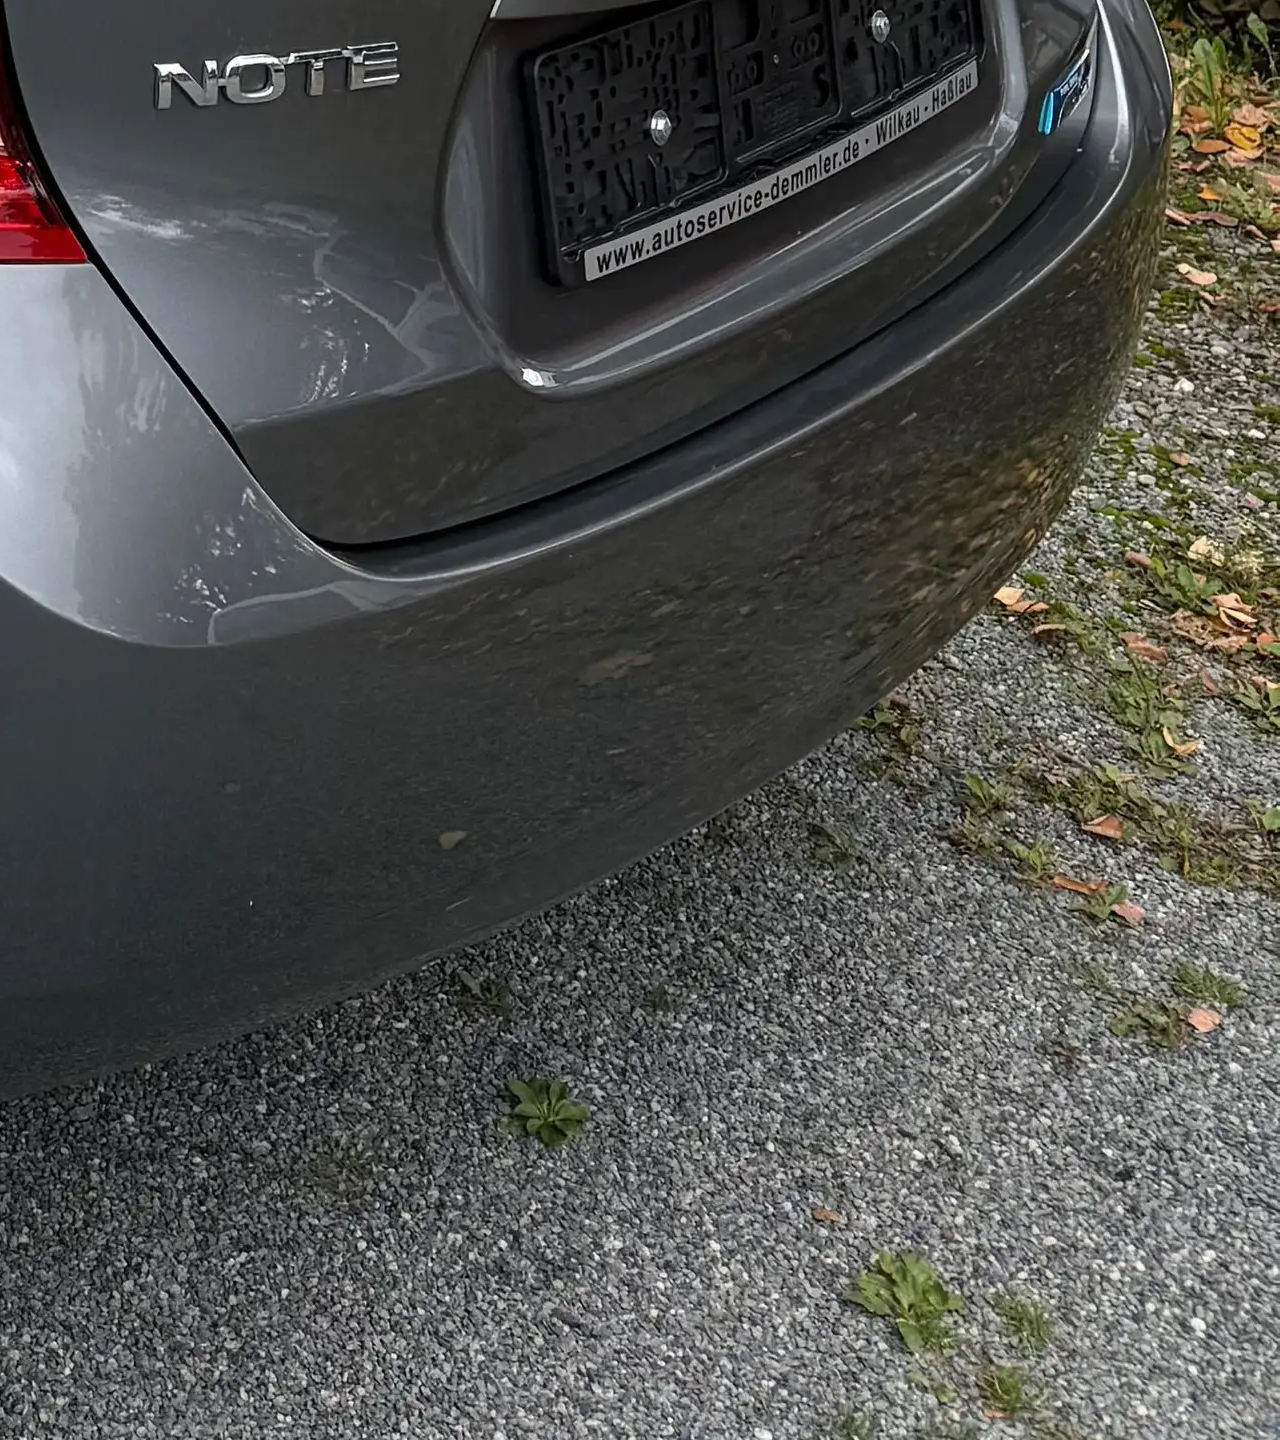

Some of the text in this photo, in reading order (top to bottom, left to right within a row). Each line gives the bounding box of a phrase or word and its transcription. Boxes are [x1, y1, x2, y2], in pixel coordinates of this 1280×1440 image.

[153, 41, 401, 110] NOTE
[596, 139, 860, 273] www.autoservice-demmler.de
[876, 105, 920, 145] Wilkau
[931, 72, 972, 113] Haßlau
